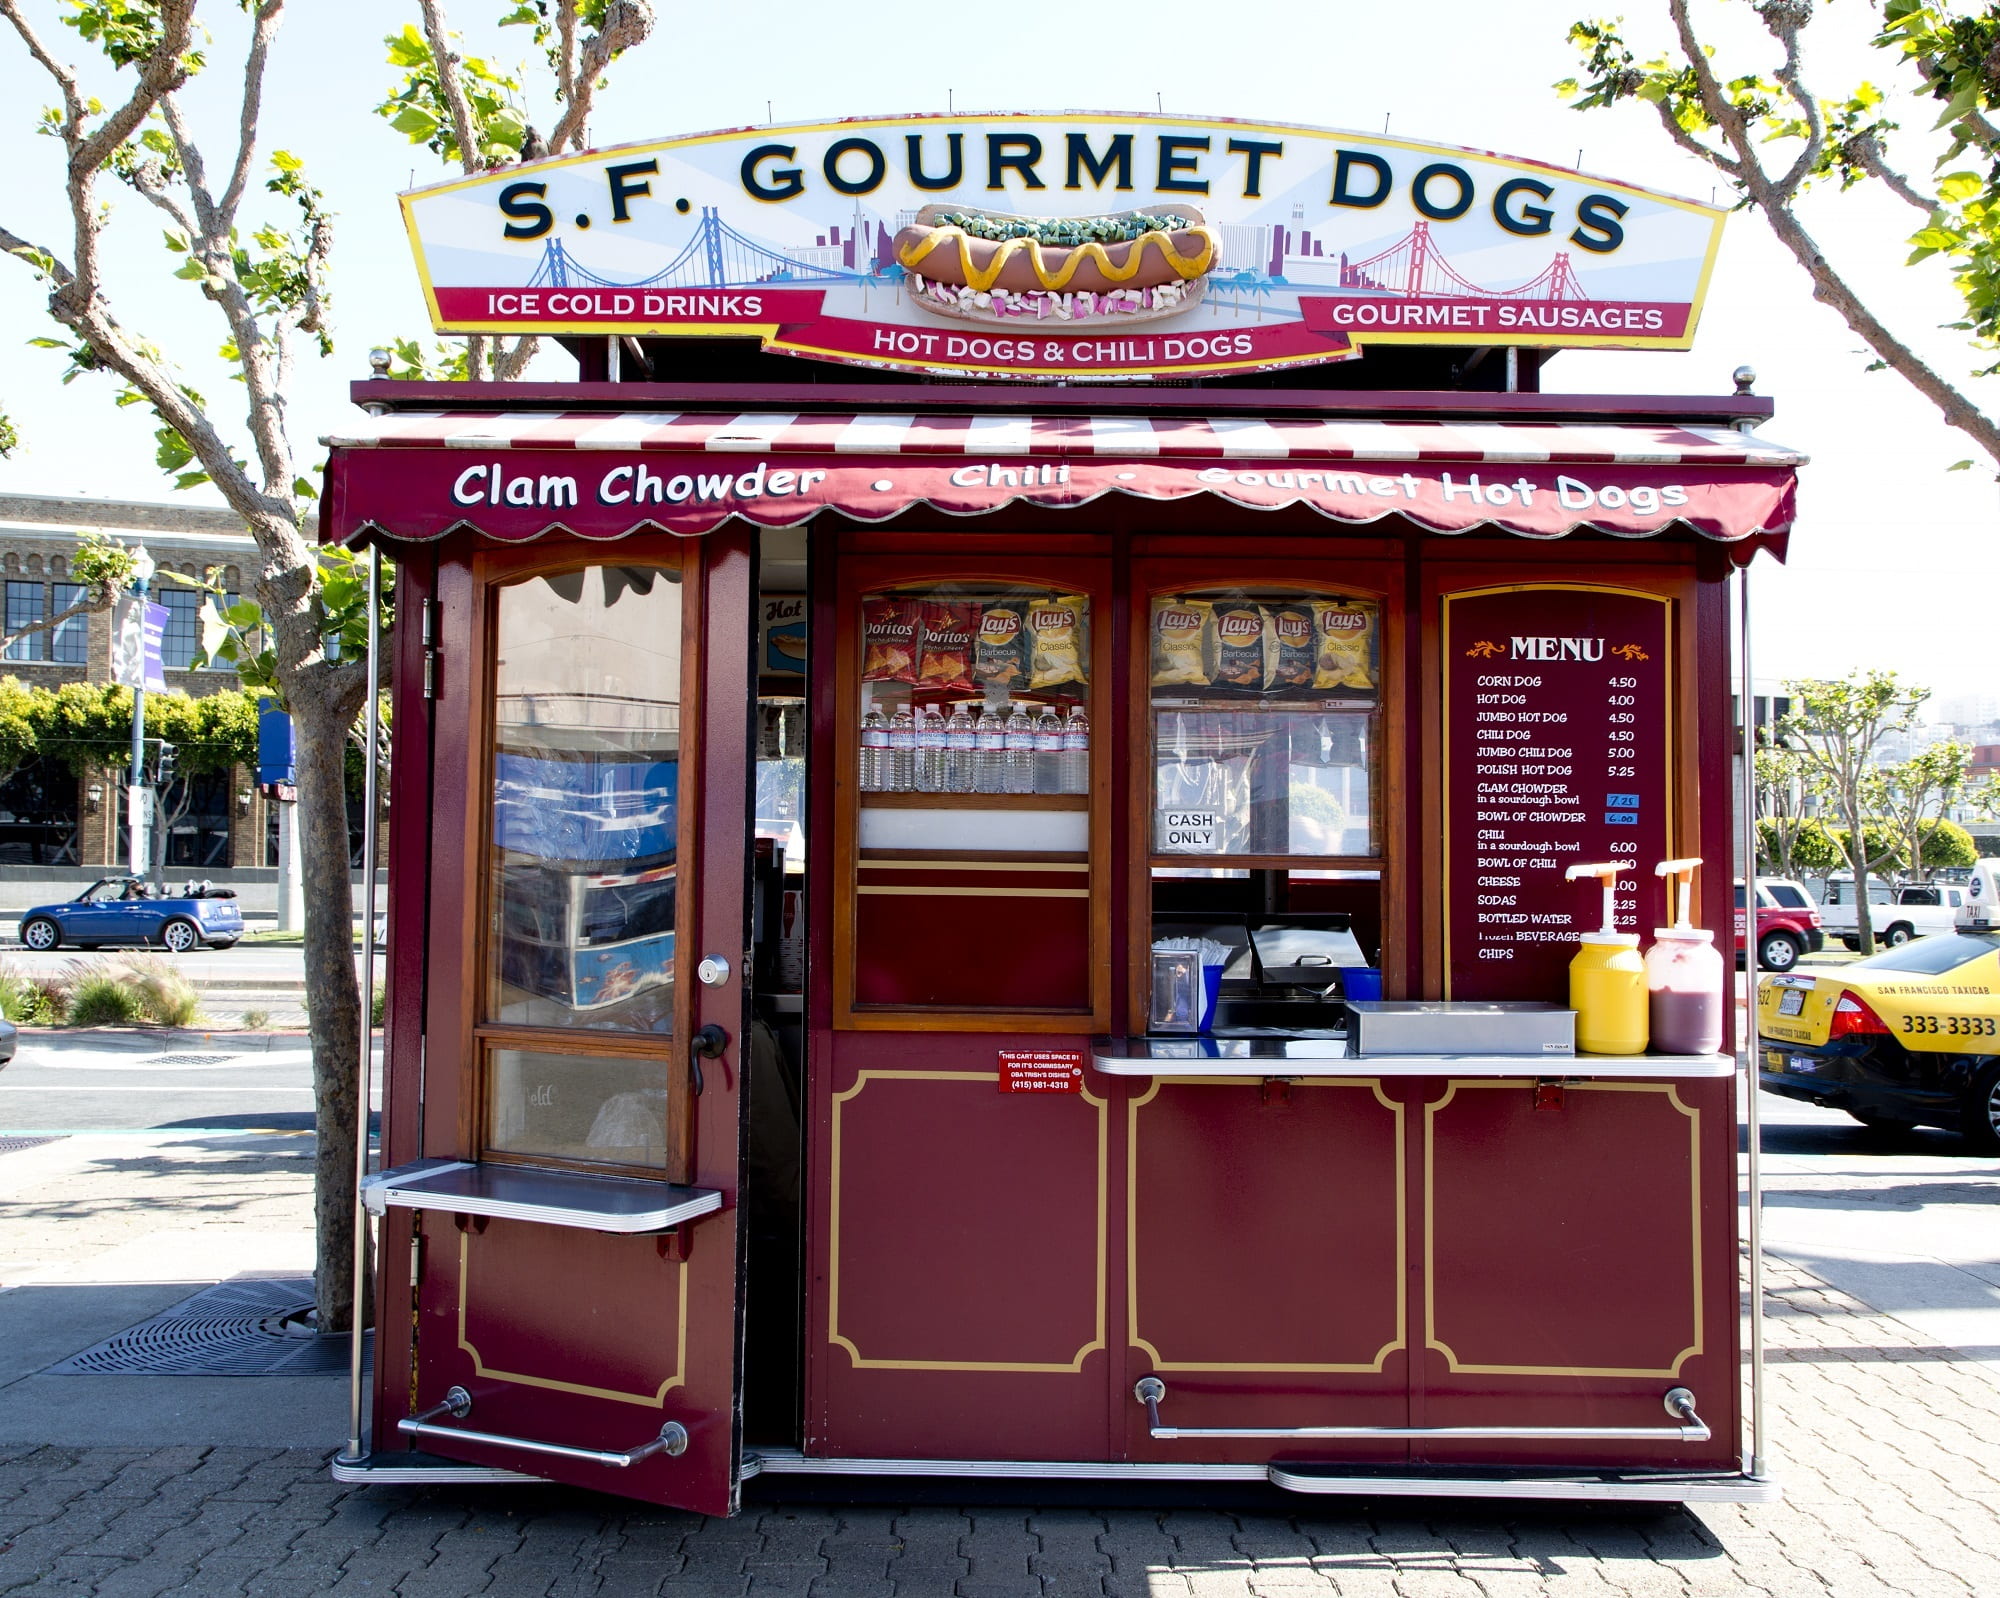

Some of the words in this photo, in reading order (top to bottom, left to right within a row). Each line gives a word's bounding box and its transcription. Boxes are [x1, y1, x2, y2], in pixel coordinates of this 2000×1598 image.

[499, 157, 691, 240] S.F.
[739, 132, 1283, 202] GOURMET
[1329, 150, 1630, 253] DOGS
[487, 293, 541, 315] ICE
[547, 294, 637, 316] COLD
[643, 295, 763, 316] DRINKS
[1332, 304, 1491, 327] GOURMET
[1499, 304, 1663, 330] SAUSAGES
[873, 329, 939, 355] HOT
[946, 337, 1035, 361] DOGS
[1042, 341, 1064, 362] &
[1072, 341, 1154, 362] CHILI
[1164, 334, 1253, 360] DOGS
[950, 463, 1070, 487] Chili
[452, 463, 579, 508] Clam
[598, 462, 826, 506] Chowder
[1196, 466, 1422, 499] Gourmet
[1441, 472, 1538, 508] Hot
[1554, 475, 1690, 516] Dogs
[766, 600, 802, 621] Hot
[979, 615, 1018, 635] Lay's
[1035, 611, 1073, 631] Lay's
[1160, 611, 1200, 630] Lay's
[1221, 616, 1260, 636] Lay's
[1326, 611, 1363, 630] Lay's
[1278, 617, 1310, 637] Lay's
[1040, 642, 1072, 651] Classic
[1327, 643, 1360, 652] Classic
[1511, 637, 1605, 661] MENU
[980, 648, 1017, 657] Barbecue
[1222, 650, 1259, 658] Barbecue
[1478, 676, 1511, 686] CORN
[1514, 676, 1542, 686] DOG
[1609, 677, 1636, 688] 4.50
[1477, 694, 1499, 704] HOT
[1502, 695, 1526, 704] DOG
[1608, 696, 1634, 705] 4.00
[1477, 712, 1515, 721] JUMBO
[1518, 712, 1540, 722] HOT
[1543, 713, 1567, 722] DOG
[1609, 713, 1634, 723] 4.50
[1477, 730, 1504, 739] CHILI
[1506, 730, 1531, 740] DOG
[1609, 731, 1634, 741] 4.50
[1477, 747, 1516, 756] JUMBO
[1518, 747, 1545, 757] CHILI
[1548, 748, 1572, 758] DOG
[1608, 748, 1634, 758] 5.00
[1477, 764, 1517, 774] POLISH
[1521, 765, 1545, 775] HOT
[1547, 765, 1572, 775] DOG
[1608, 766, 1635, 776] 5.25
[1478, 783, 1508, 792] CLAM
[1511, 784, 1567, 793] CHOWDER
[1477, 794, 1487, 802] in
[1498, 795, 1552, 807] sourdough
[1554, 795, 1579, 804] bowl
[1610, 796, 1634, 806] 7.25
[1168, 814, 1213, 826] CASH
[1477, 812, 1510, 821] BOWL
[1512, 812, 1527, 821] OF
[1529, 812, 1586, 822] CHOWDER
[1609, 814, 1633, 823] 6.00
[1168, 831, 1213, 844] ONLY
[1478, 830, 1504, 839] CHILI
[1478, 841, 1487, 849] in
[1499, 841, 1552, 853] sourdough
[1555, 842, 1580, 851] bowl
[1610, 842, 1637, 852] 6.00
[1478, 858, 1510, 867] BOWL
[1513, 859, 1527, 867] OF
[1530, 858, 1556, 868] CHILI
[1478, 876, 1520, 886] CHEESE
[1612, 880, 1637, 891] .00
[1478, 895, 1516, 905] SODAS
[1966, 905, 1980, 919] TAXI
[1478, 913, 1528, 923] BOTTLED
[1531, 914, 1572, 924] WATER
[1479, 949, 1513, 959] CHIPS
[1877, 986, 1896, 994] SAN
[1899, 986, 1949, 995] FRANCISCO
[1952, 986, 1991, 995] TAXICAB
[1902, 1015, 1996, 1036] 333-3333
[1011, 1080, 1032, 1090] (415)
[1033, 1081, 1069, 1089] 981-4318
